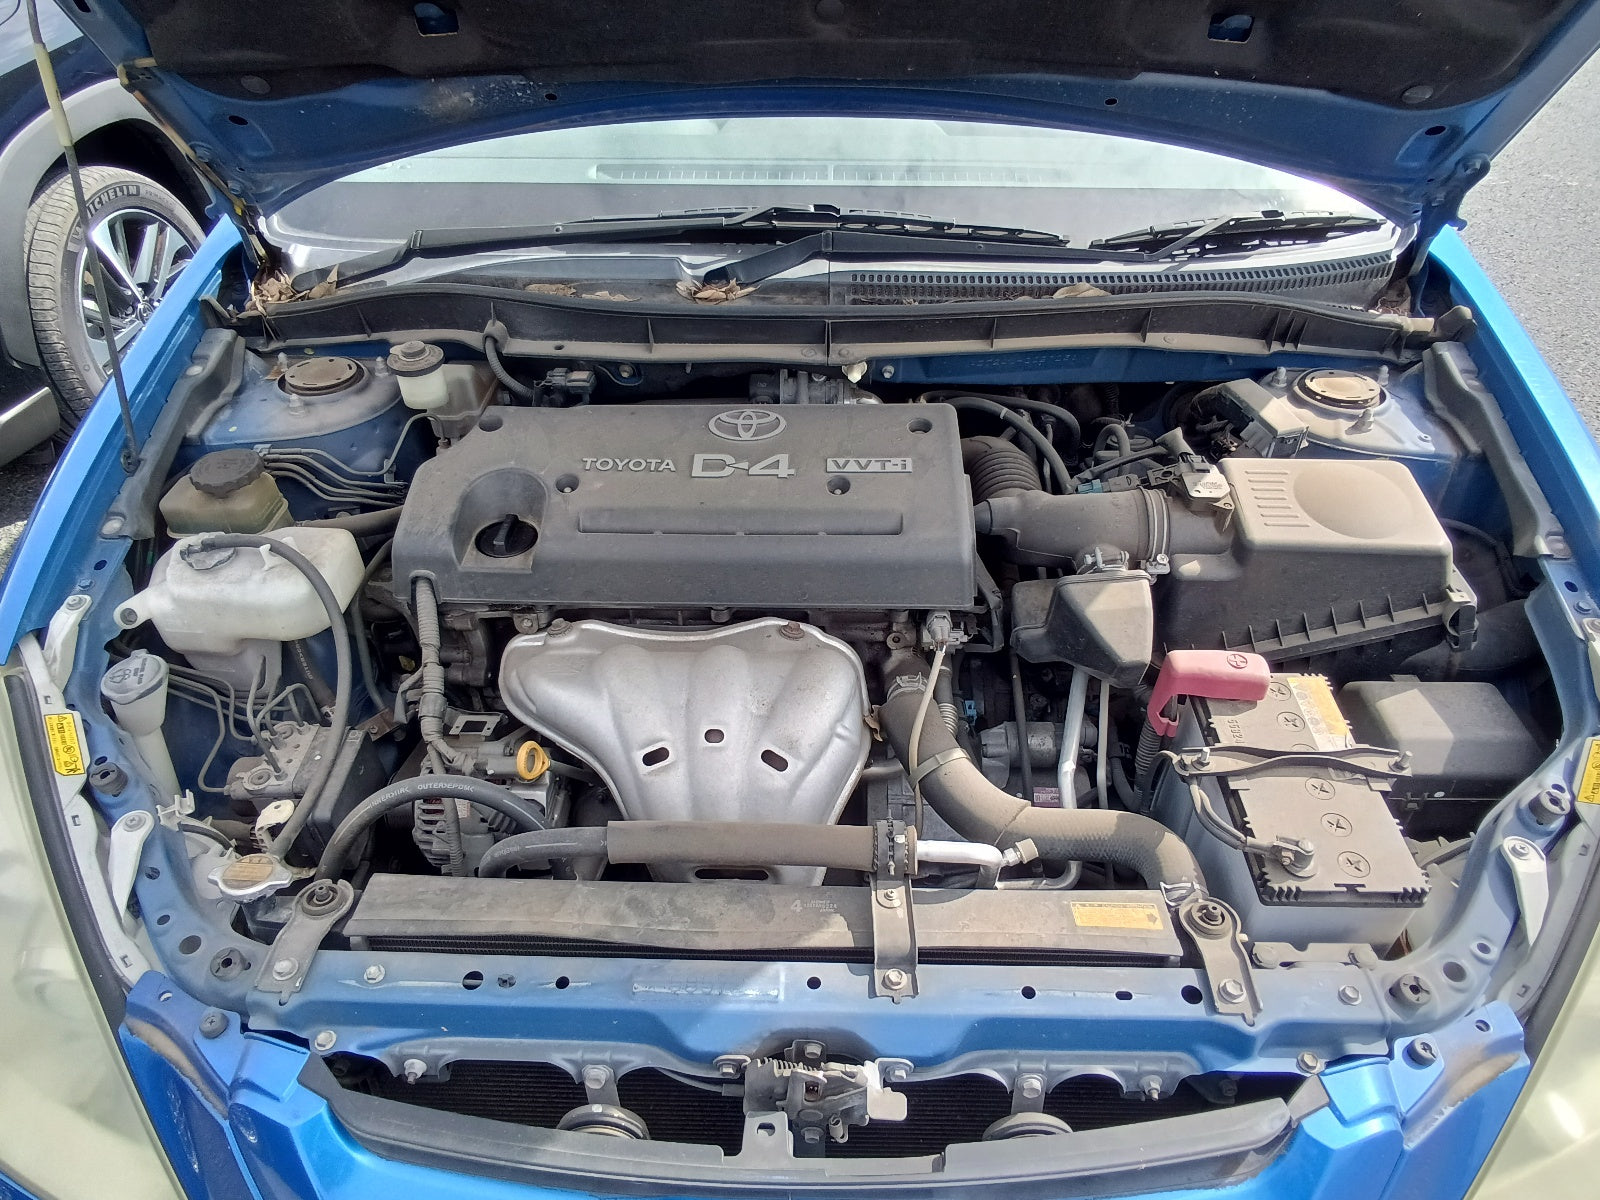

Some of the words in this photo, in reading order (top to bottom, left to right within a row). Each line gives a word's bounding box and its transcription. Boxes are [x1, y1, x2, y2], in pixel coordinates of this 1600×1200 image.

[582, 457, 677, 472] TOYOTA
[691, 453, 795, 479] D-4
[828, 458, 911, 473] VVT-i
[790, 899, 803, 912] 4
